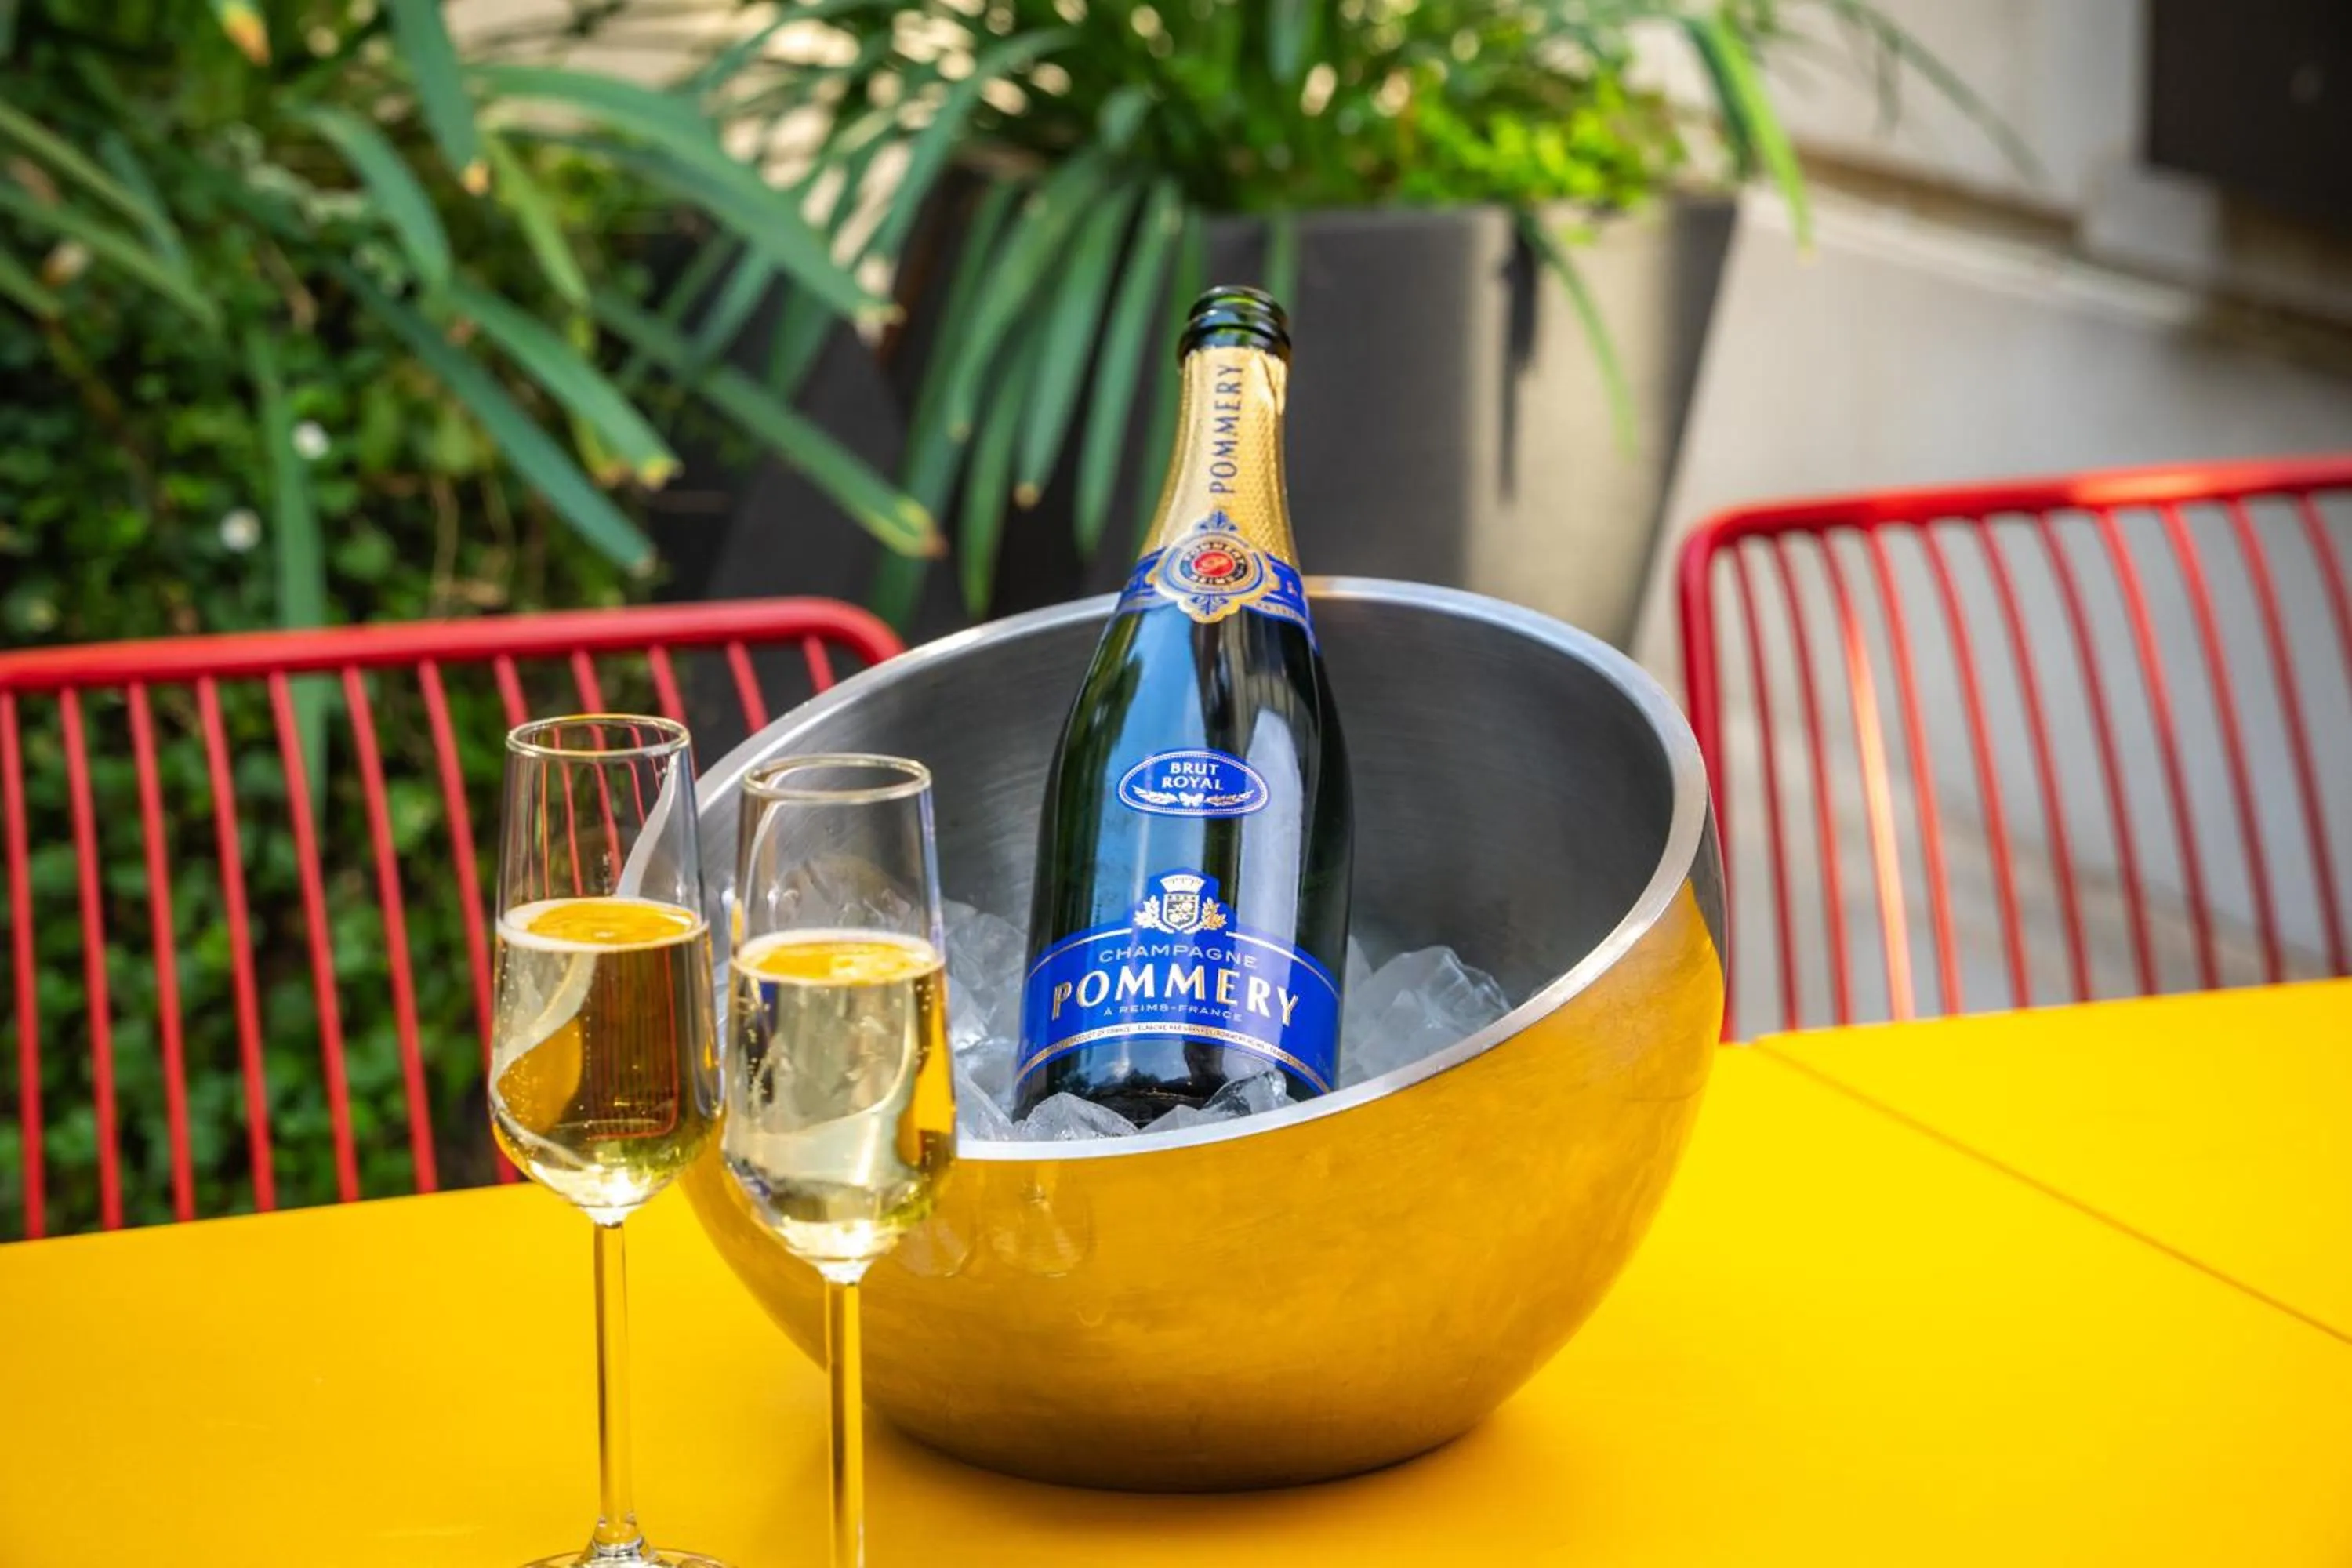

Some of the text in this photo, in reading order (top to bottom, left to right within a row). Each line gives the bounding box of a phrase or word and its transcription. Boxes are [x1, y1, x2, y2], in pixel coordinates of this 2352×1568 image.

[1208, 364, 1243, 495] POMMERY
[1170, 761, 1220, 775] BRUT
[1161, 775, 1224, 791] ROYAL
[1099, 944, 1258, 969] CHAMPAGNE
[1051, 963, 1300, 1028] POMMERY
